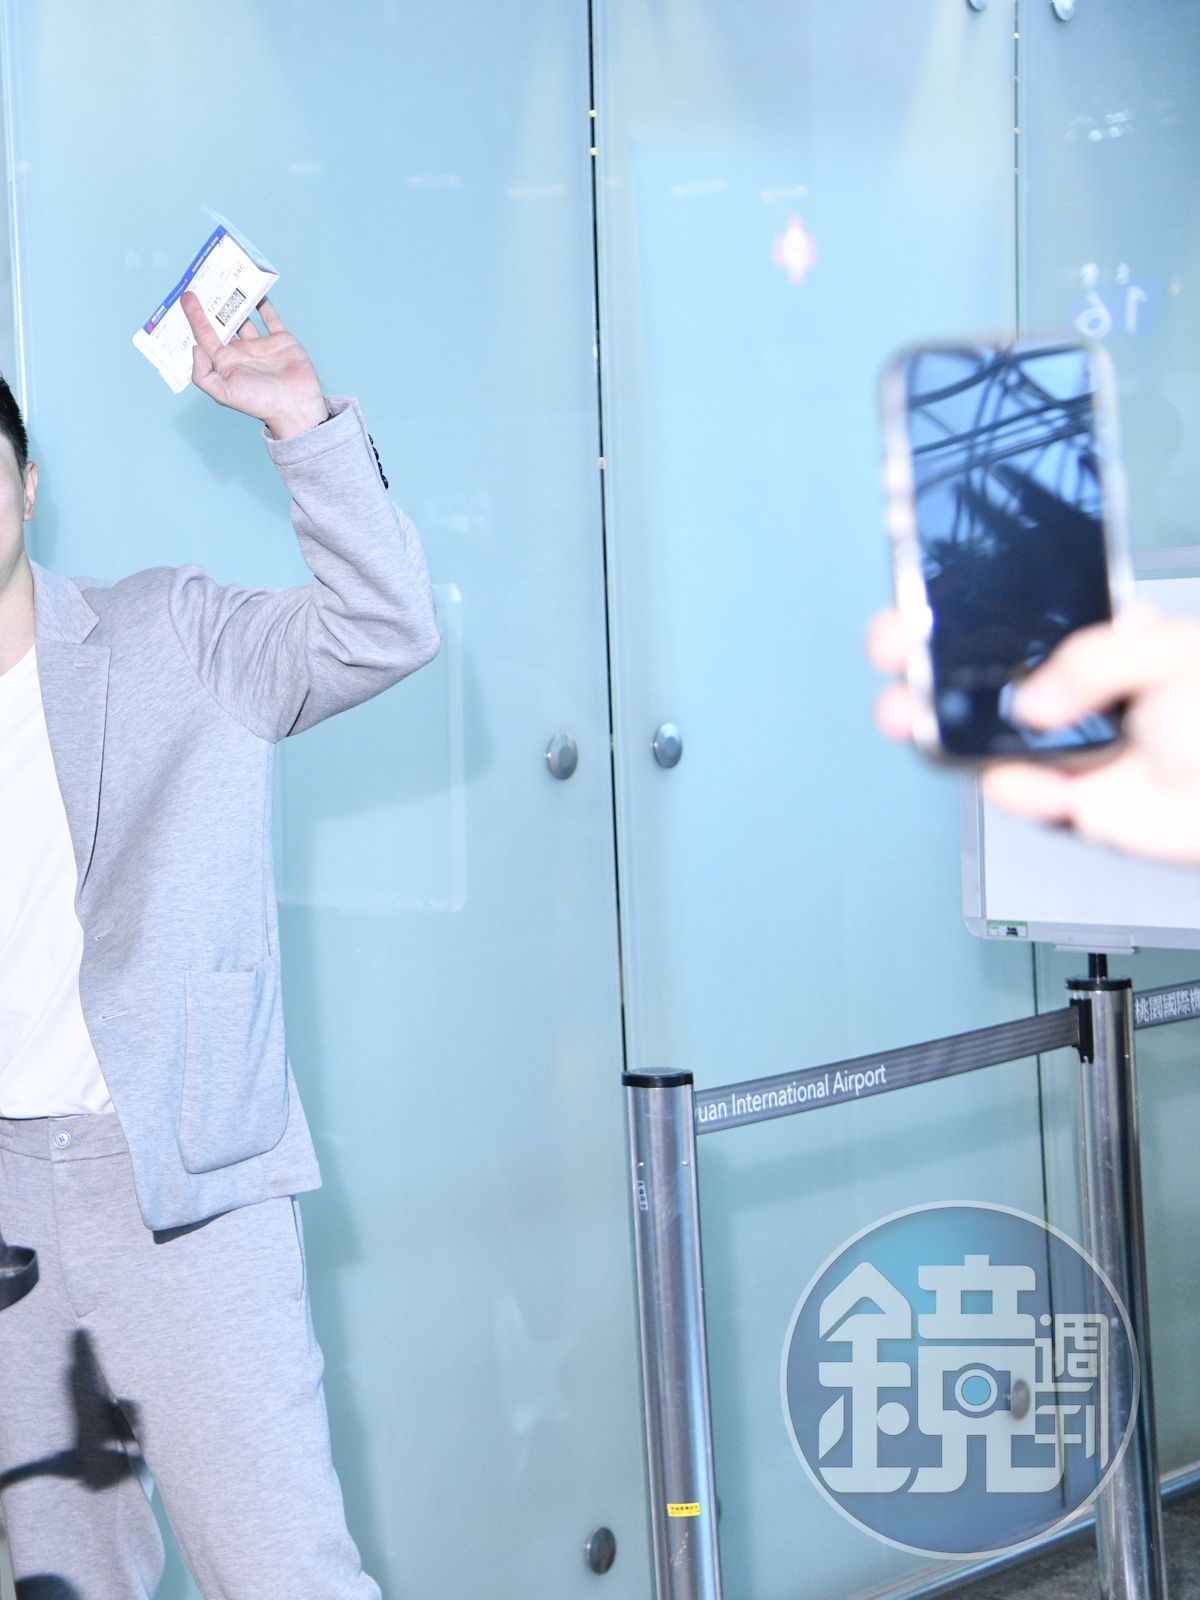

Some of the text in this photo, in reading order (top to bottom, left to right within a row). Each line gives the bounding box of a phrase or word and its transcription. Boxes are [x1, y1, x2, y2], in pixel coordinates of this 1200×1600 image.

[697, 1064, 887, 1124] uan International Airport
